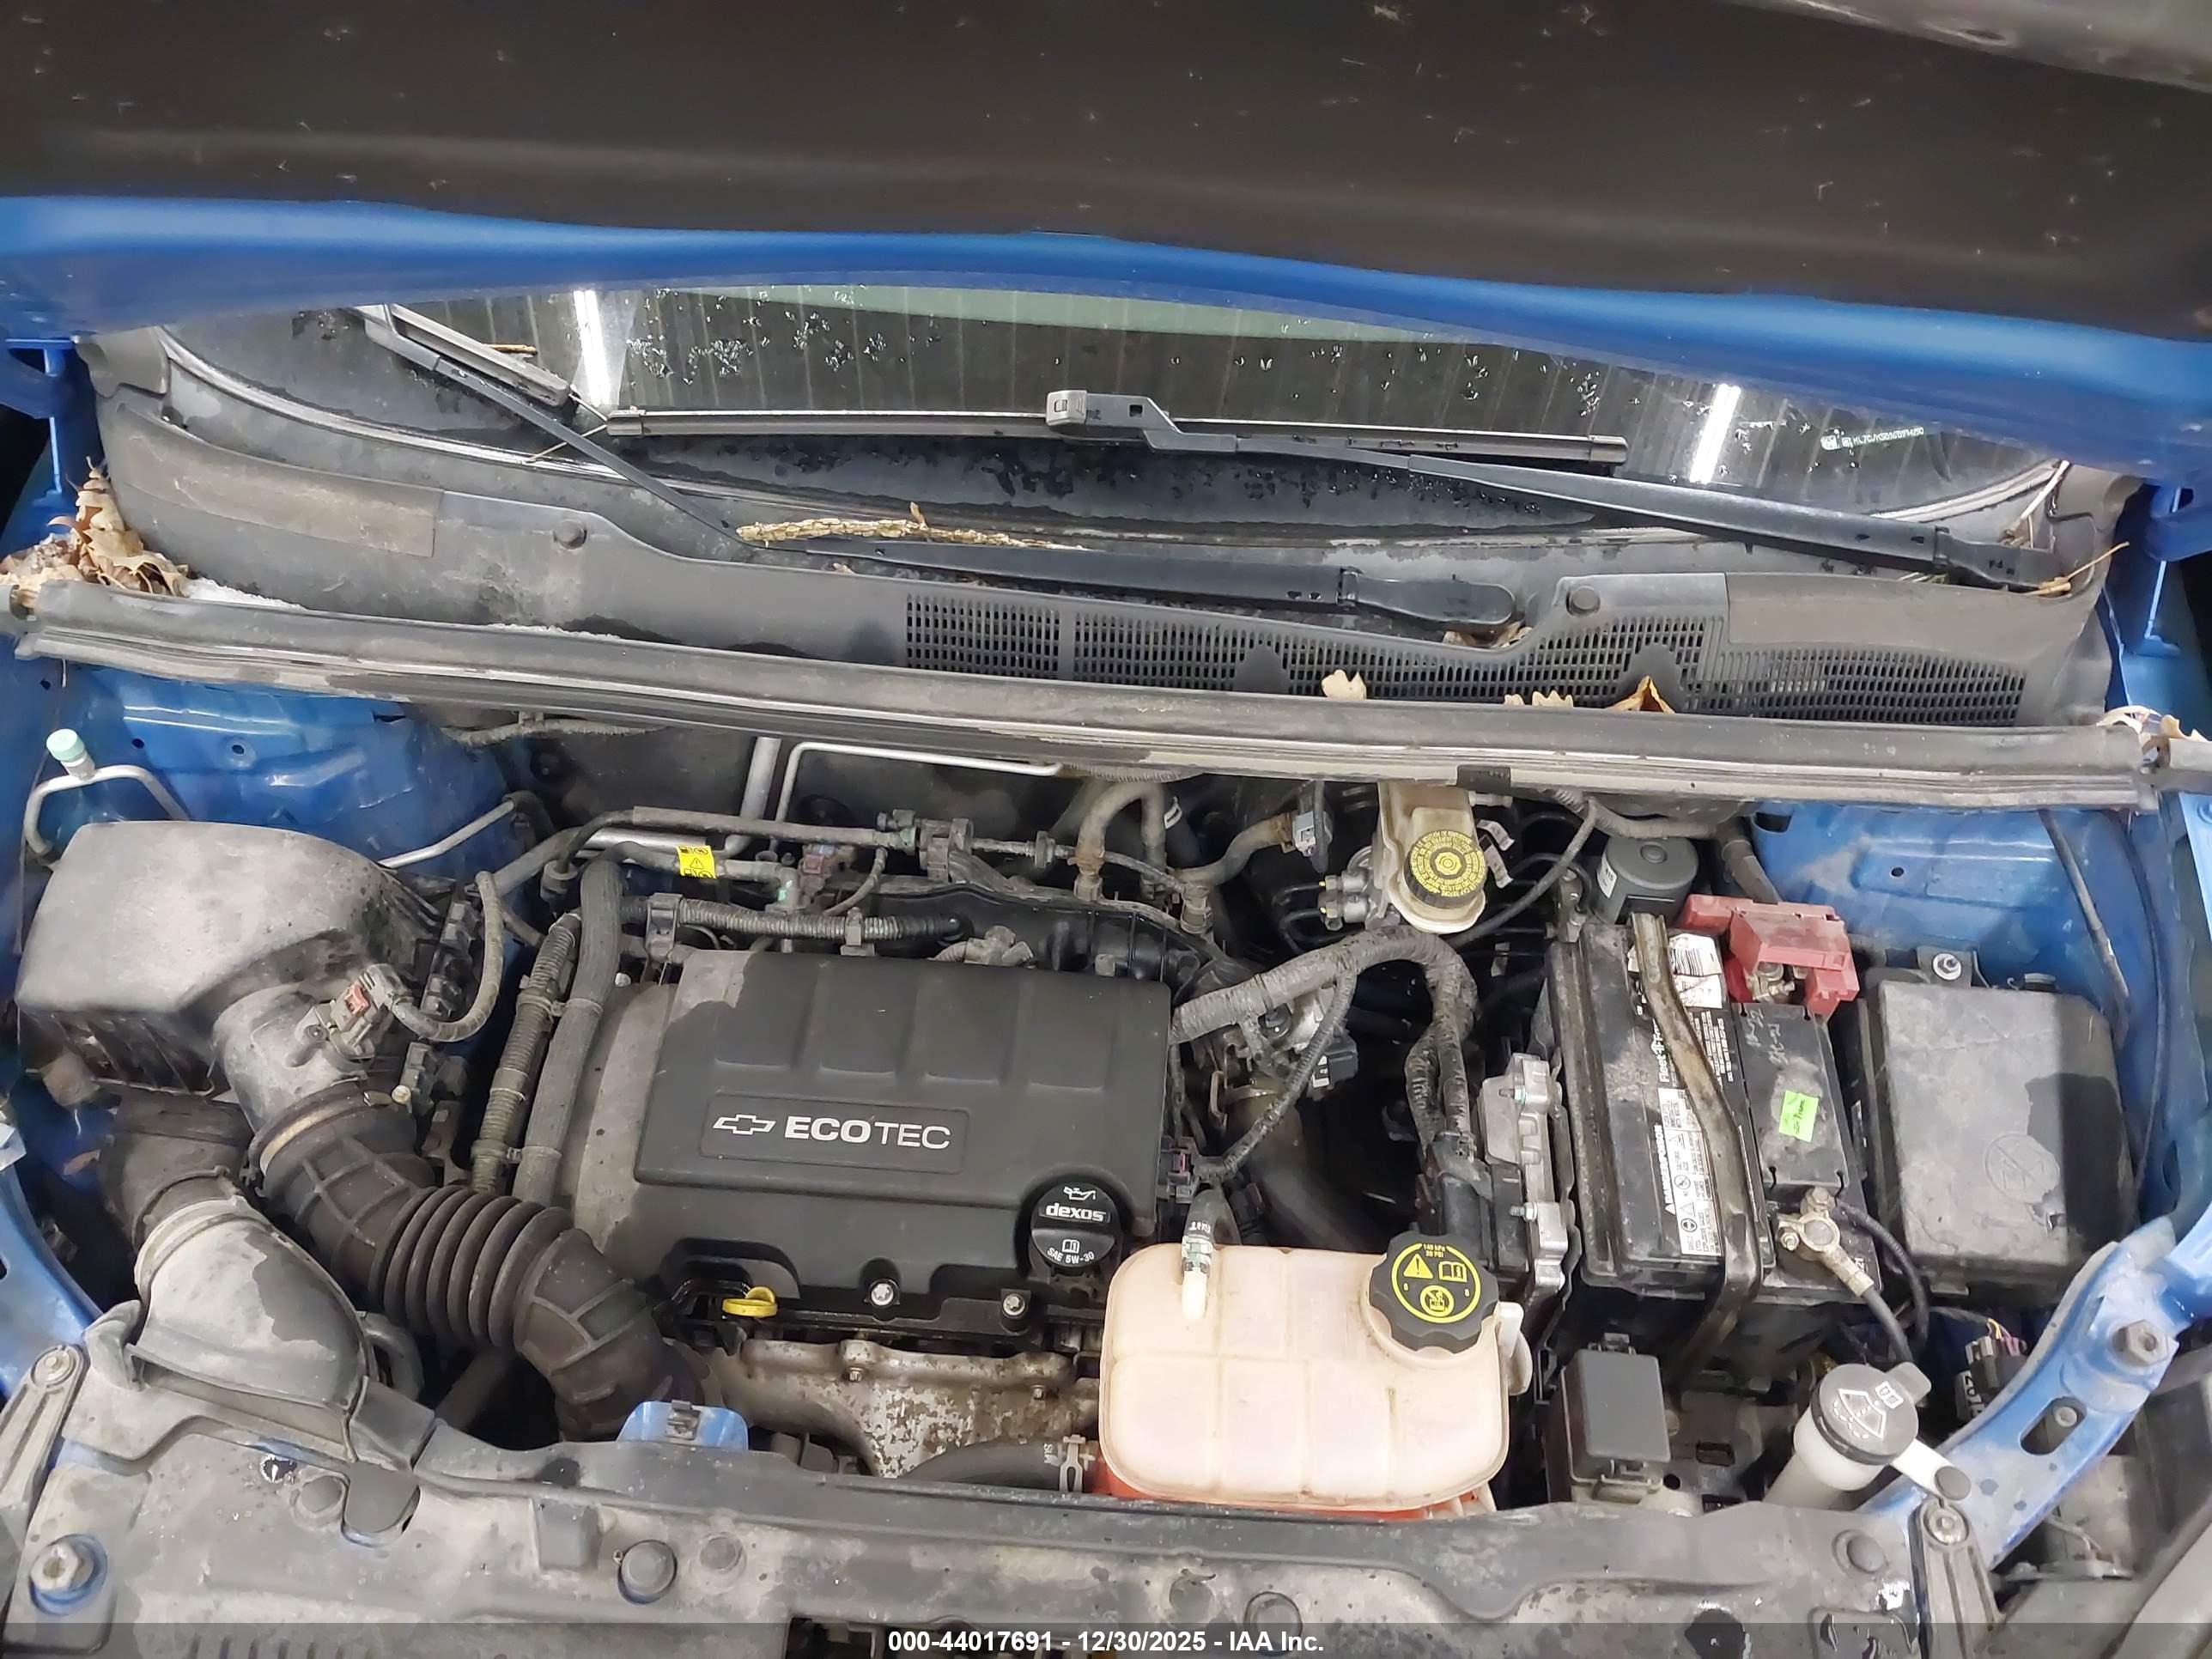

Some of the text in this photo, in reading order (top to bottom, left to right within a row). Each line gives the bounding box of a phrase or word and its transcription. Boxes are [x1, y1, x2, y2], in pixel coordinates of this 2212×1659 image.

[1656, 1054, 1670, 1083] Fleet
[785, 1116, 950, 1149] ECOTEC
[1046, 1202, 1106, 1222] dexos
[1047, 1247, 1095, 1264] SAE 5W-30
